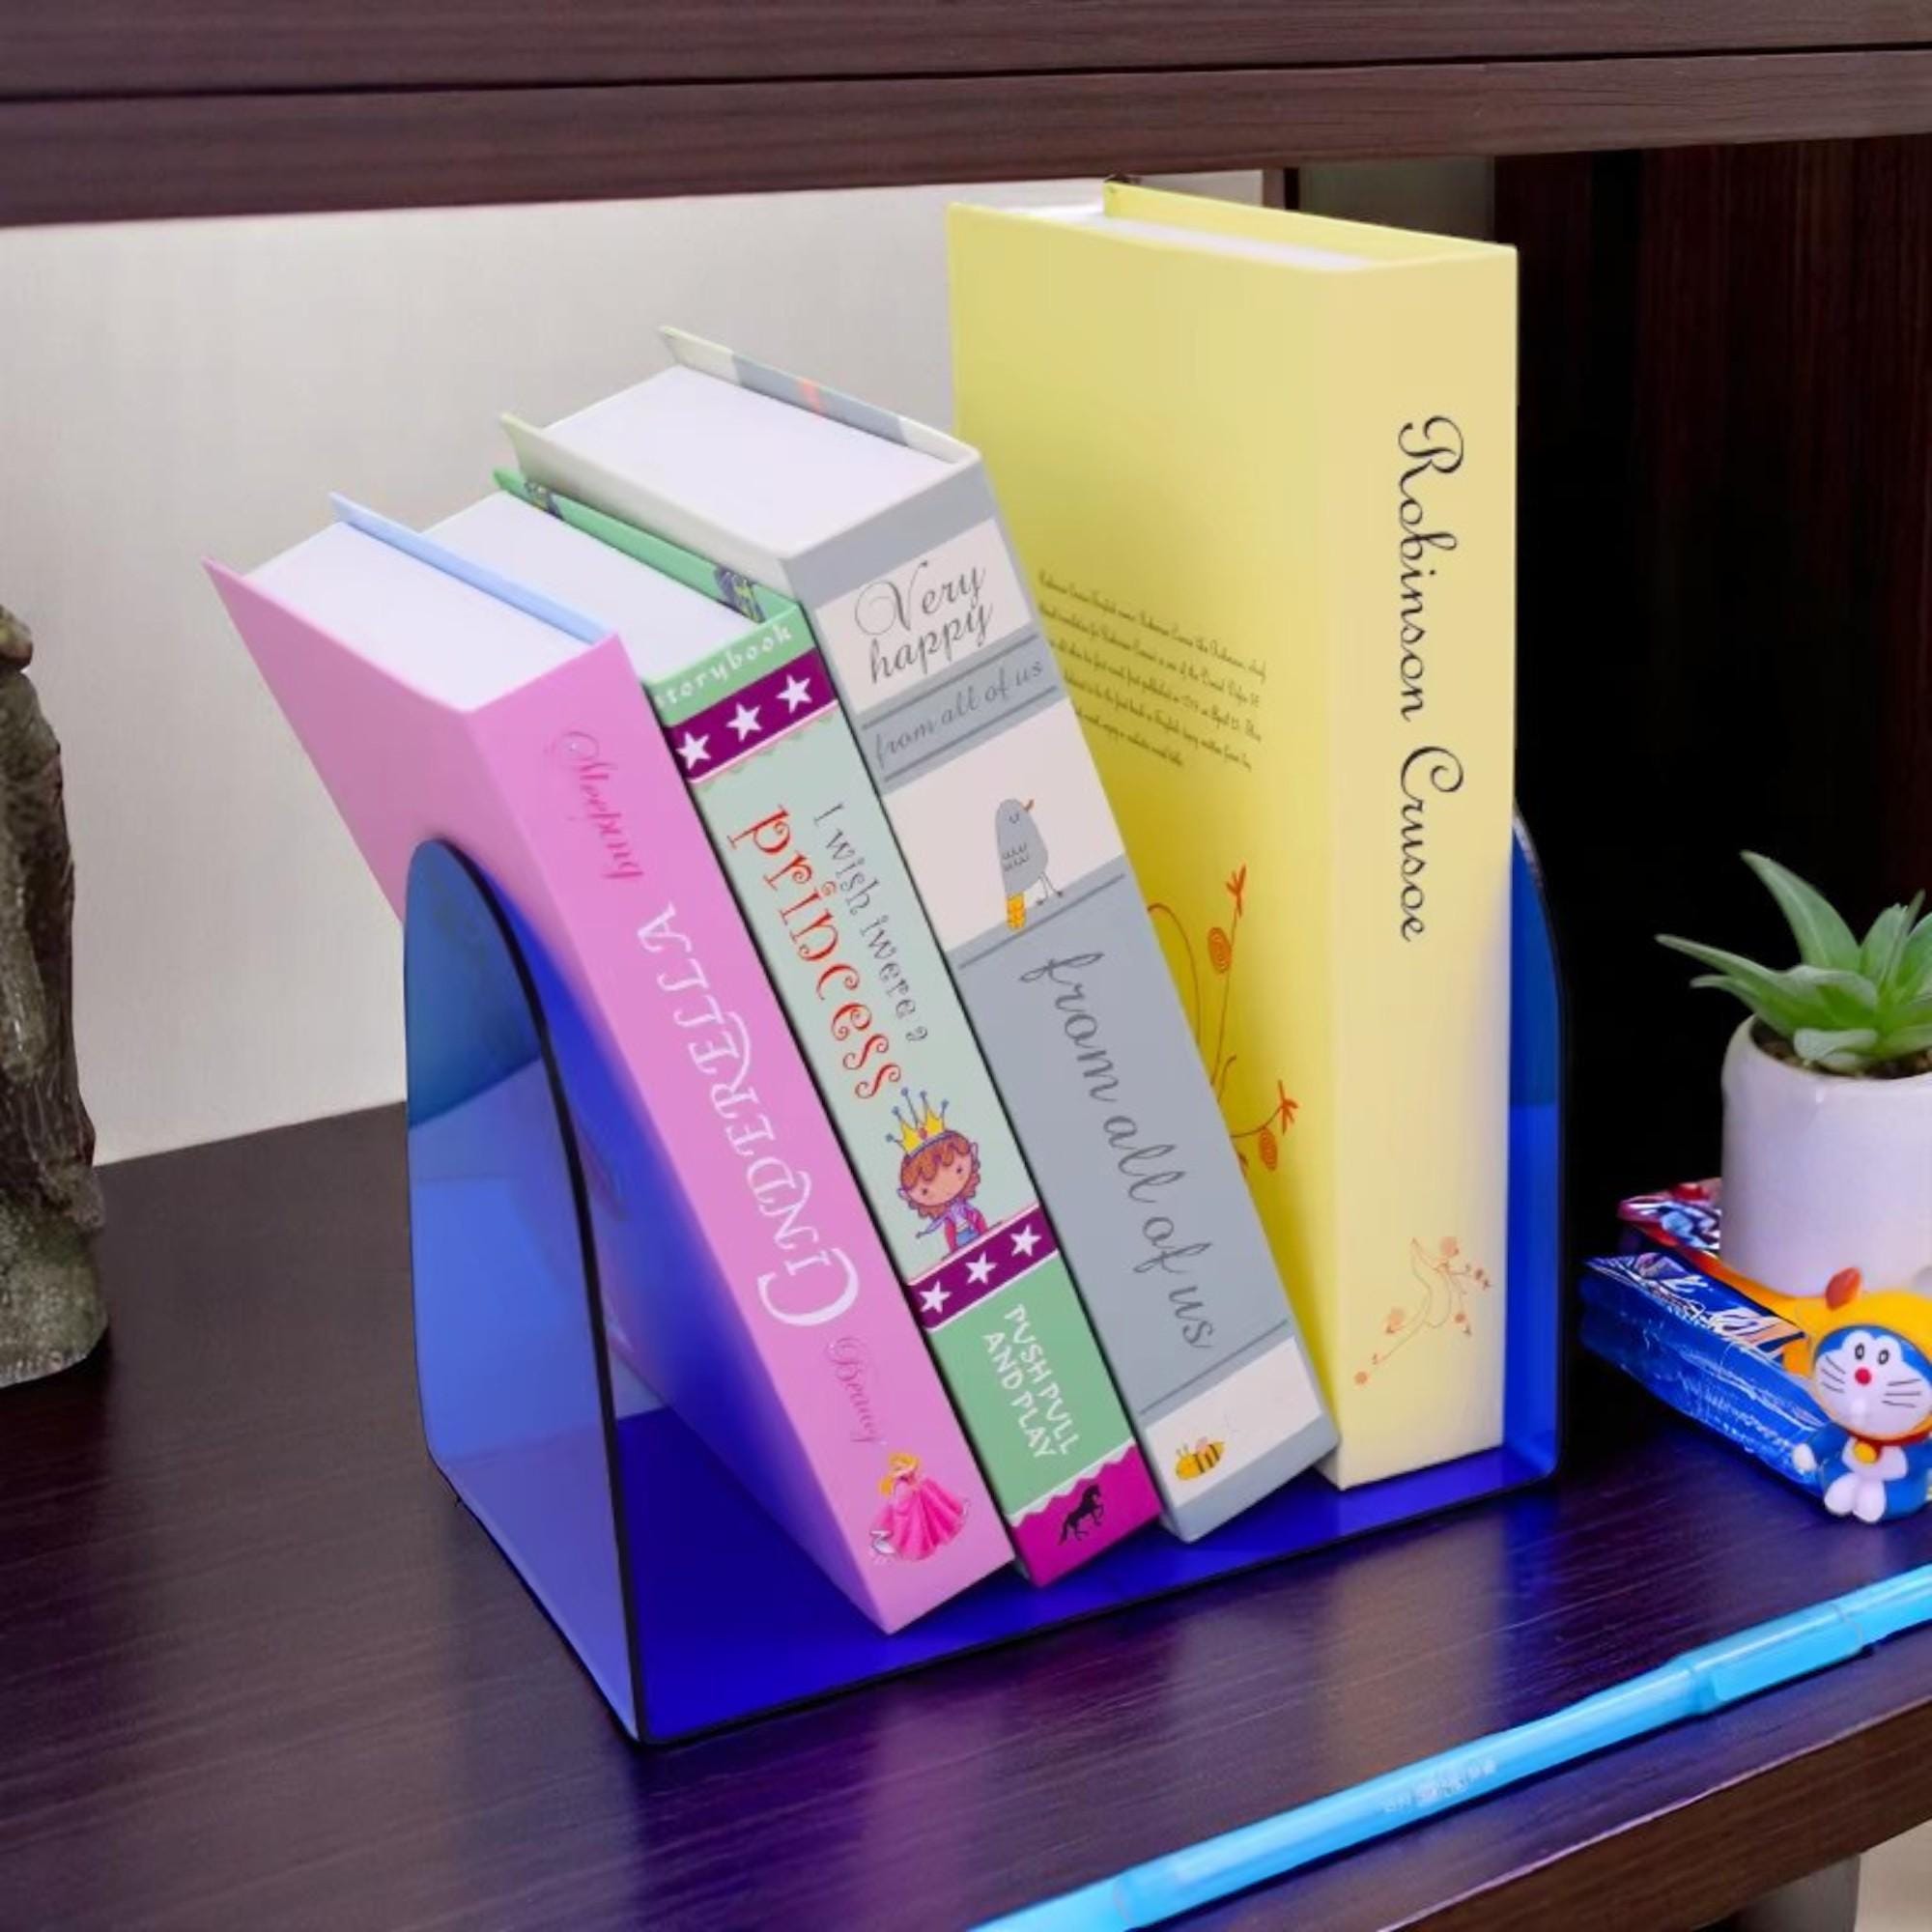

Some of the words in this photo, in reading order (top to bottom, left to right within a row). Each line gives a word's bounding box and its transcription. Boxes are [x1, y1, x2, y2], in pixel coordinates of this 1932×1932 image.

[854, 558, 987, 636] Very
[1397, 414, 1465, 724] Robinson
[870, 602, 994, 685] happy
[875, 723, 936, 770] from
[941, 685, 979, 724] all
[984, 667, 1009, 703] of
[1015, 660, 1044, 688] us
[813, 802, 844, 826] I
[1399, 746, 1465, 943] Crusoe
[825, 829, 880, 916] wish
[726, 804, 902, 1099] princess
[1018, 951, 1119, 1103] from
[1101, 1114, 1187, 1204] all
[1133, 1216, 1214, 1275] of
[1167, 1286, 1215, 1350] us
[981, 1331, 1024, 1390] AND
[1010, 1389, 1058, 1459] PLAY
[1004, 1303, 1053, 1384] PUSH
[1037, 1381, 1080, 1456] PULL
